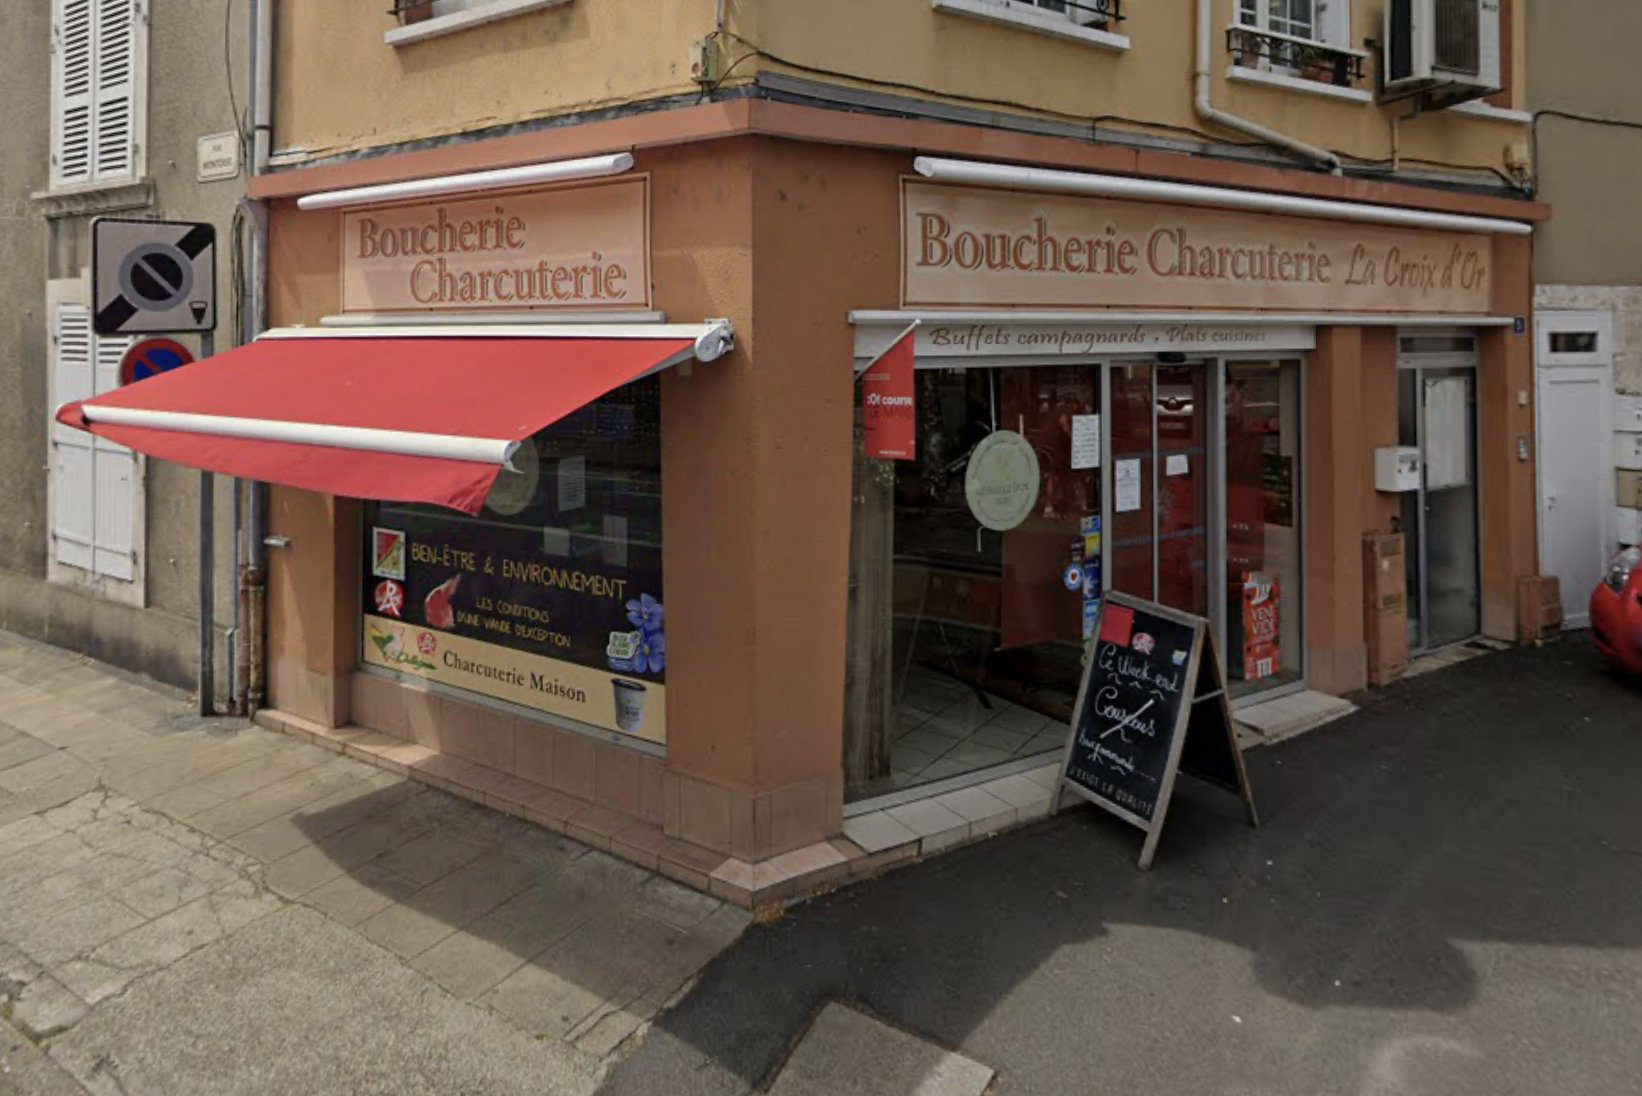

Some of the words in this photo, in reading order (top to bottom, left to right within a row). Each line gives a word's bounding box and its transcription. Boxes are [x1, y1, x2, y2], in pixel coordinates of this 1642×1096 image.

[357, 205, 526, 259] Boucherie
[916, 212, 1138, 276] Boucherie
[1146, 225, 1332, 285] Charcuterie
[1345, 243, 1376, 287] La
[1383, 247, 1438, 296] Croix
[1440, 243, 1486, 291] d'Or
[409, 250, 627, 304] Charcuterie
[929, 325, 1011, 352] Buffets
[1017, 324, 1147, 354] campagnards
[1165, 325, 1207, 344] Plats
[484, 556, 495, 576] &
[502, 558, 628, 600] ENVIRONNEMENT
[476, 596, 493, 611] LES
[497, 601, 550, 623] CONDITIONS
[442, 650, 525, 687] Charcuterie
[529, 671, 587, 704] Maison
